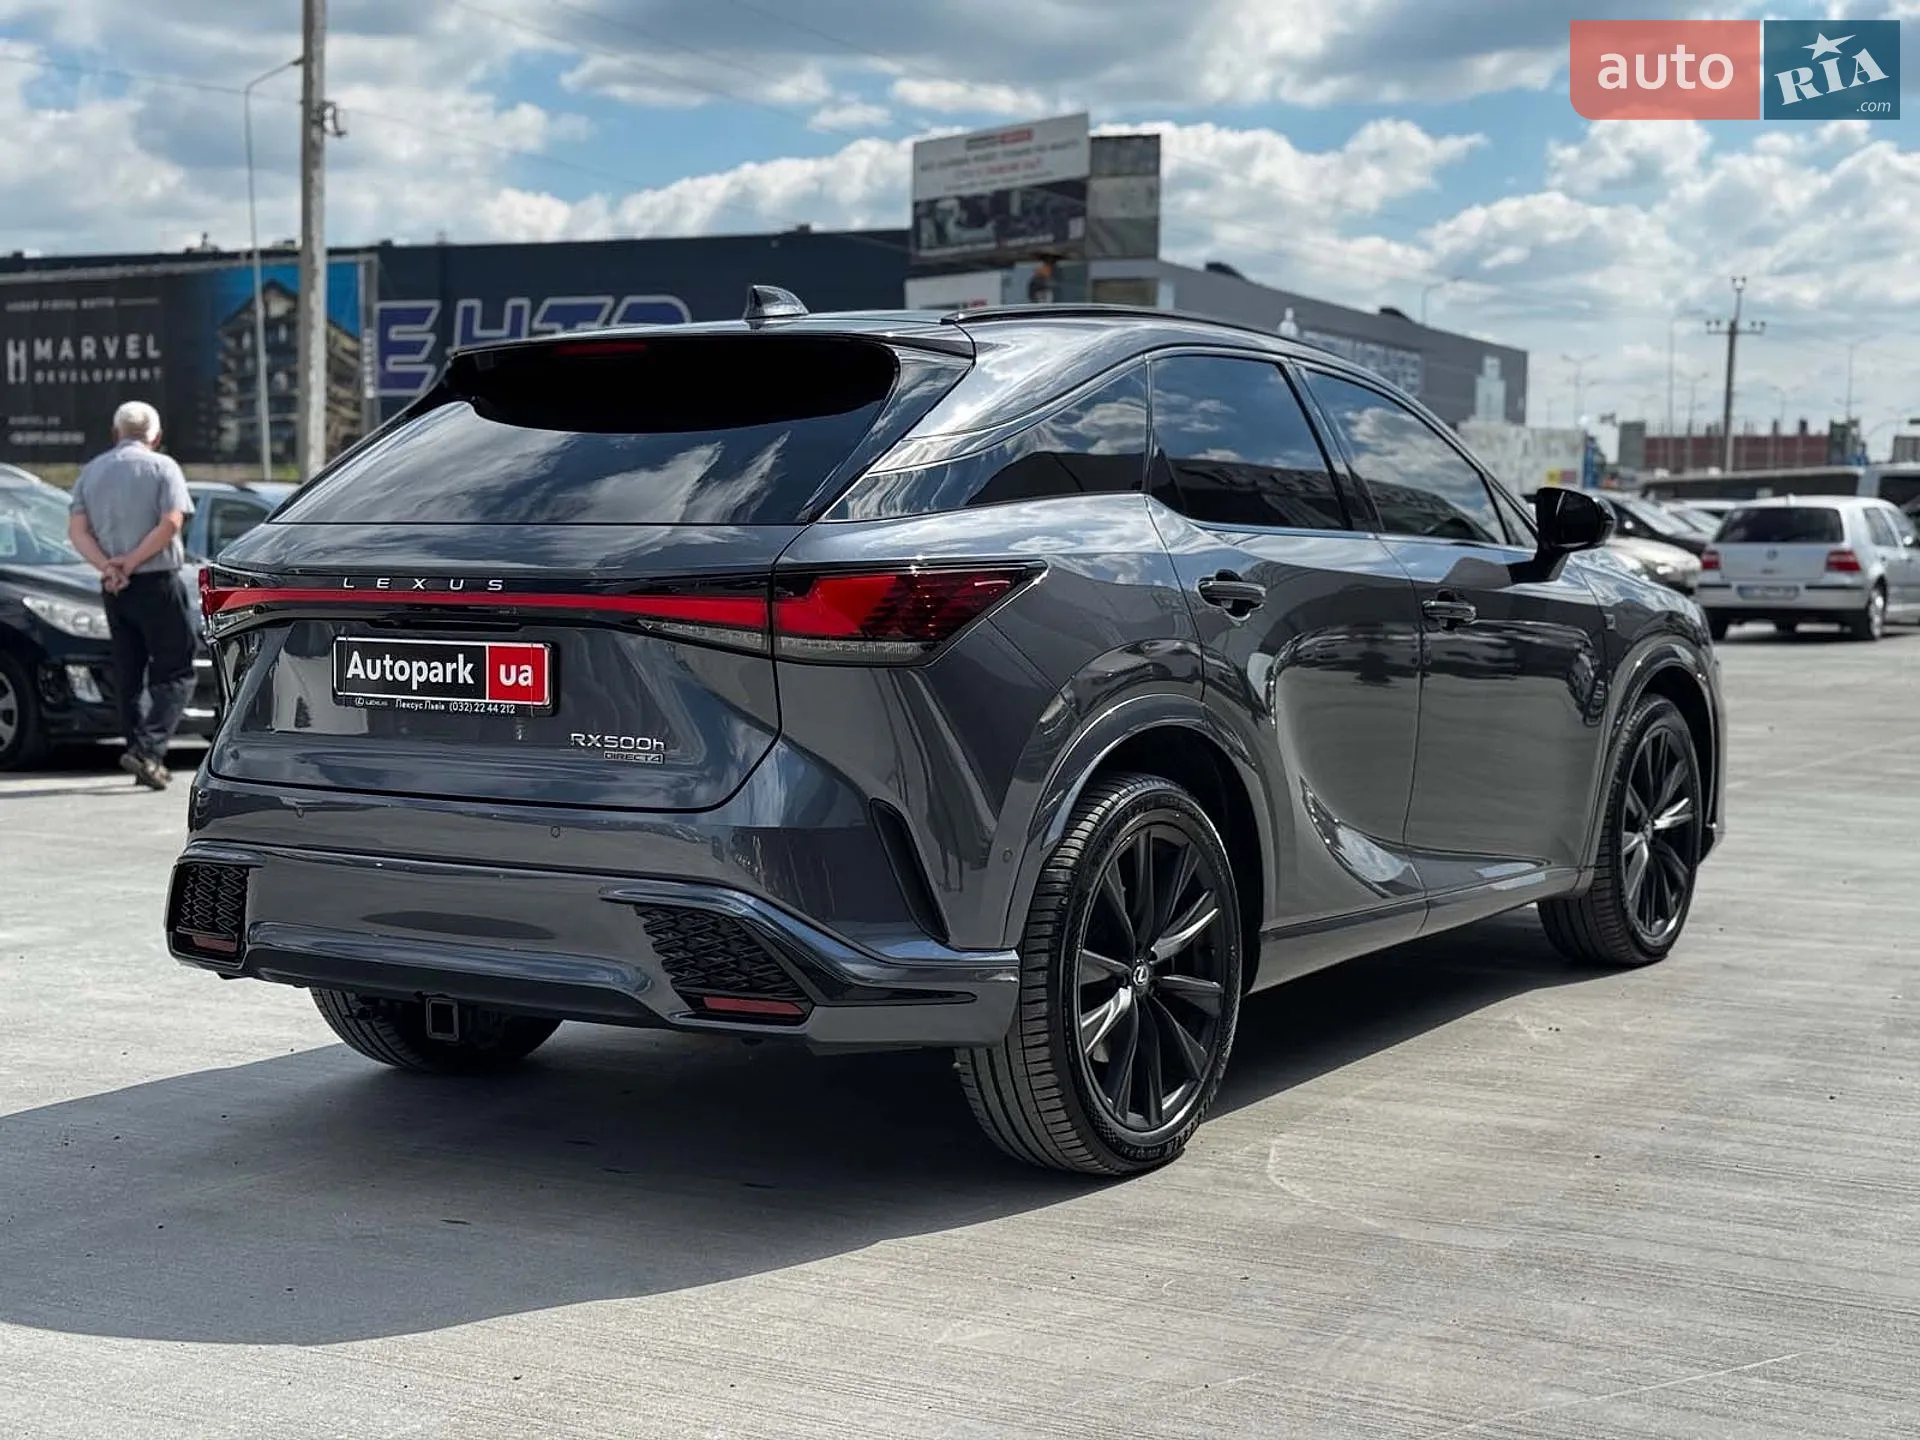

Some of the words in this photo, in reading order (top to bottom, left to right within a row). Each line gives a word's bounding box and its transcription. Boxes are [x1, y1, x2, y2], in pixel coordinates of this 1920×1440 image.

[33, 333, 162, 362] MARVEL
[34, 367, 163, 384] DEVELOPMENT
[342, 577, 504, 592] LEXUS
[346, 650, 475, 691] Autopark
[499, 663, 534, 687] ua
[449, 701, 473, 714] (032)
[570, 733, 665, 751] RX500h
